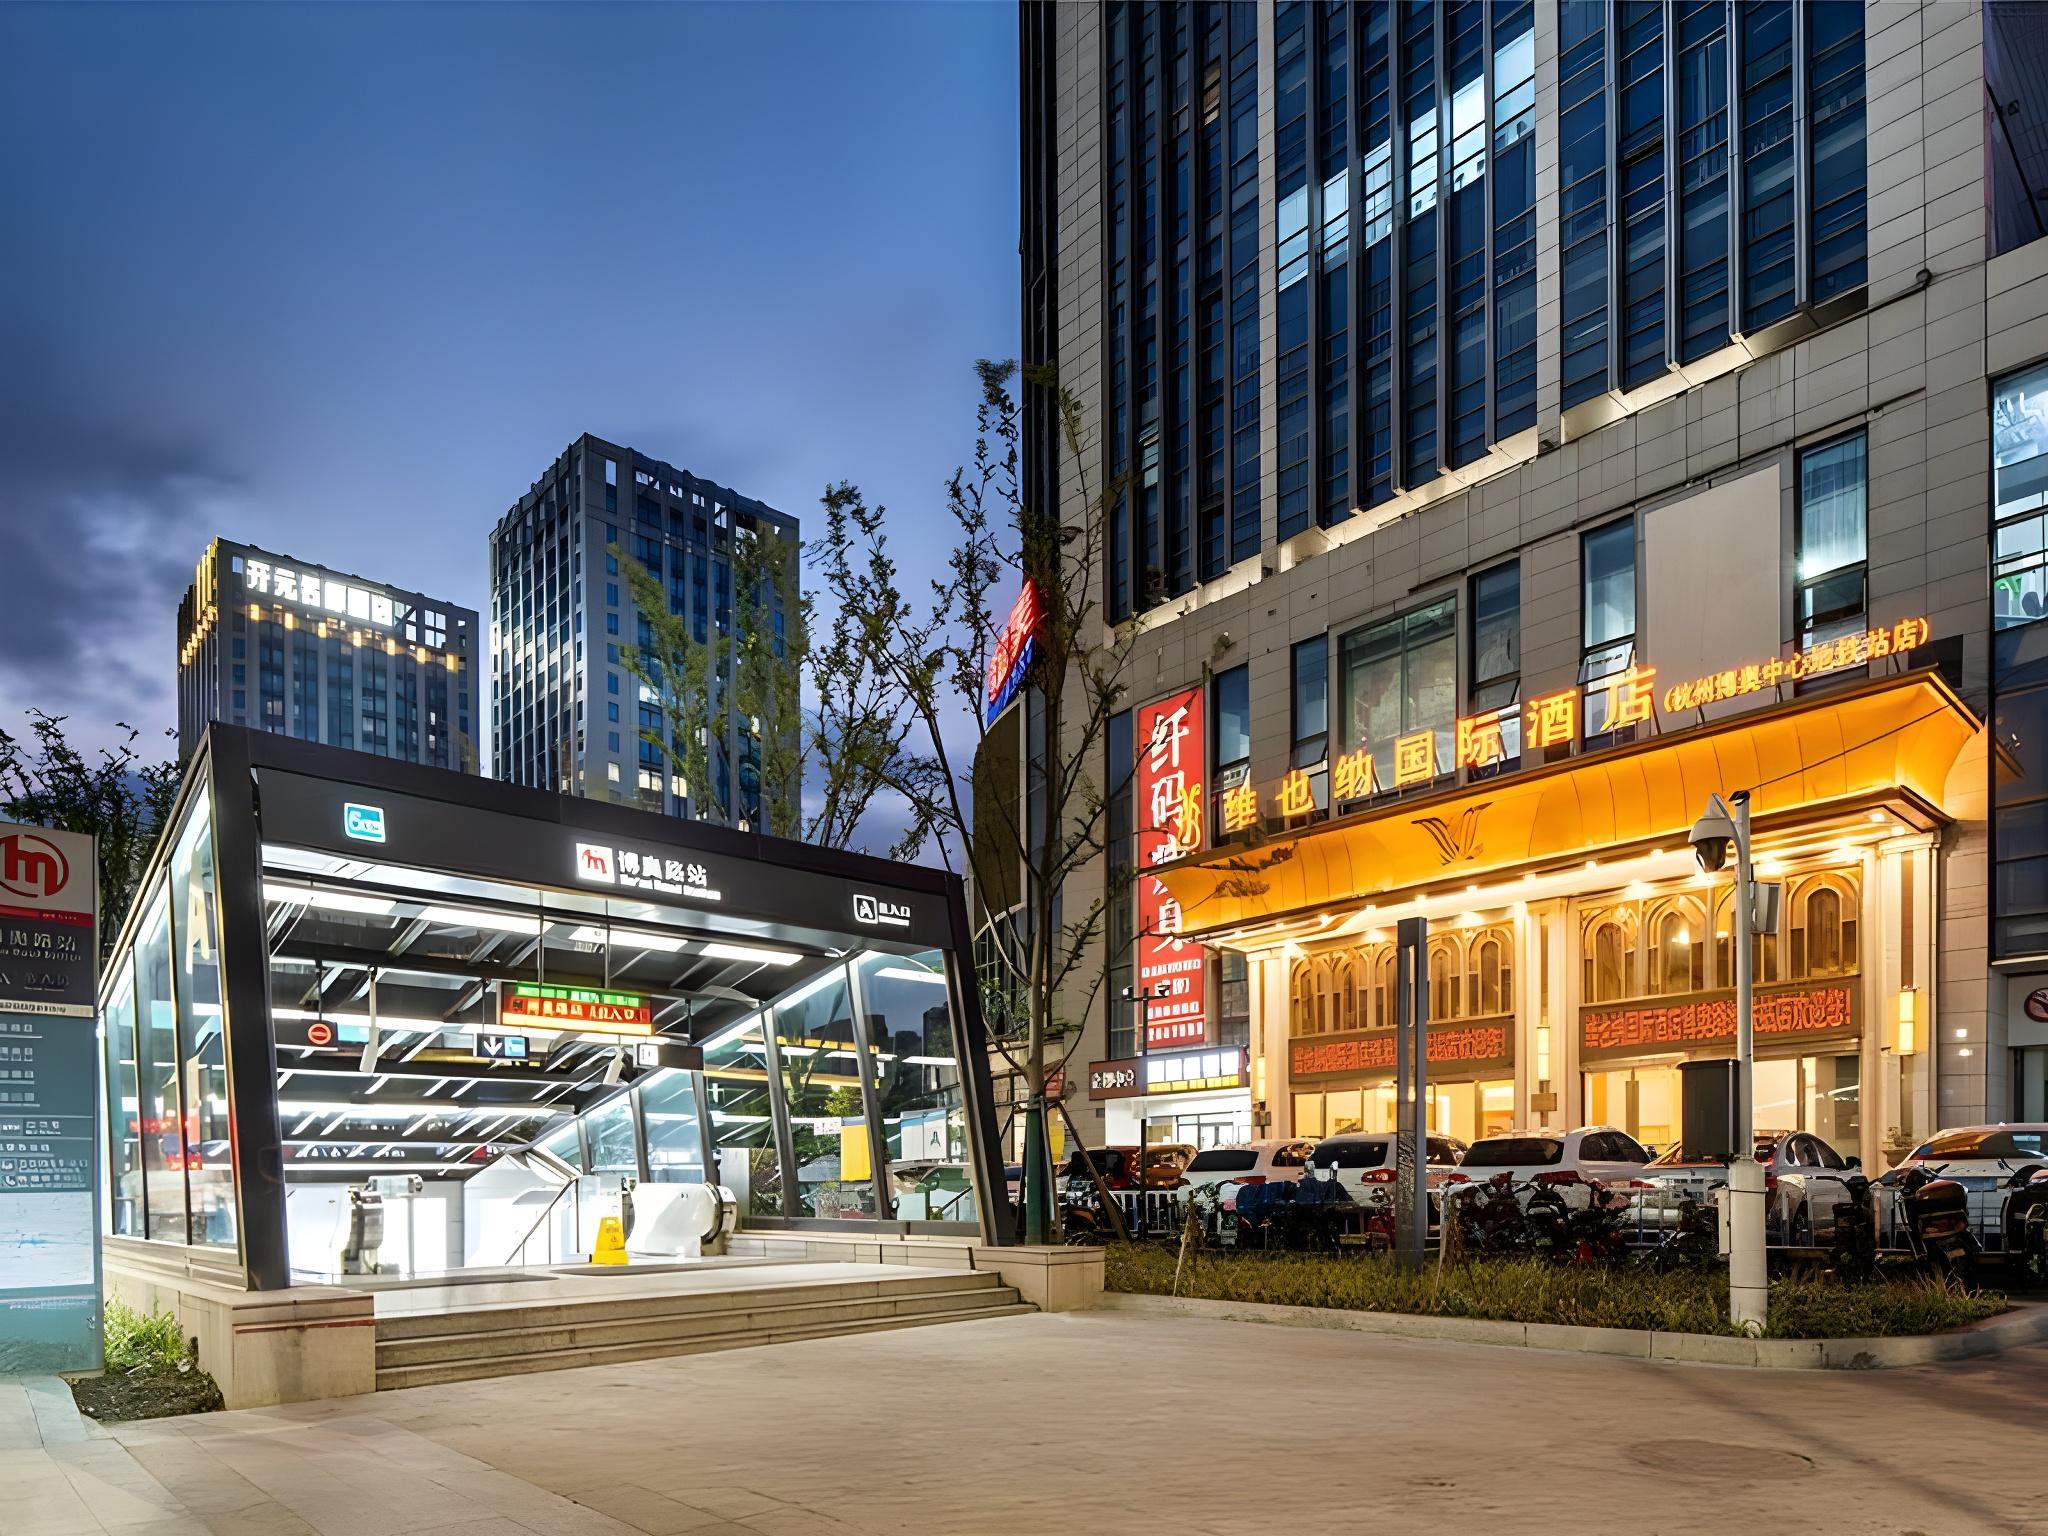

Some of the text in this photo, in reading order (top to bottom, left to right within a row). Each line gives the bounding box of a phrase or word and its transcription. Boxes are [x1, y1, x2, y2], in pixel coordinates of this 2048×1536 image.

[1223, 667, 1656, 832] 维也纳国际酒店
[860, 900, 874, 919] A
